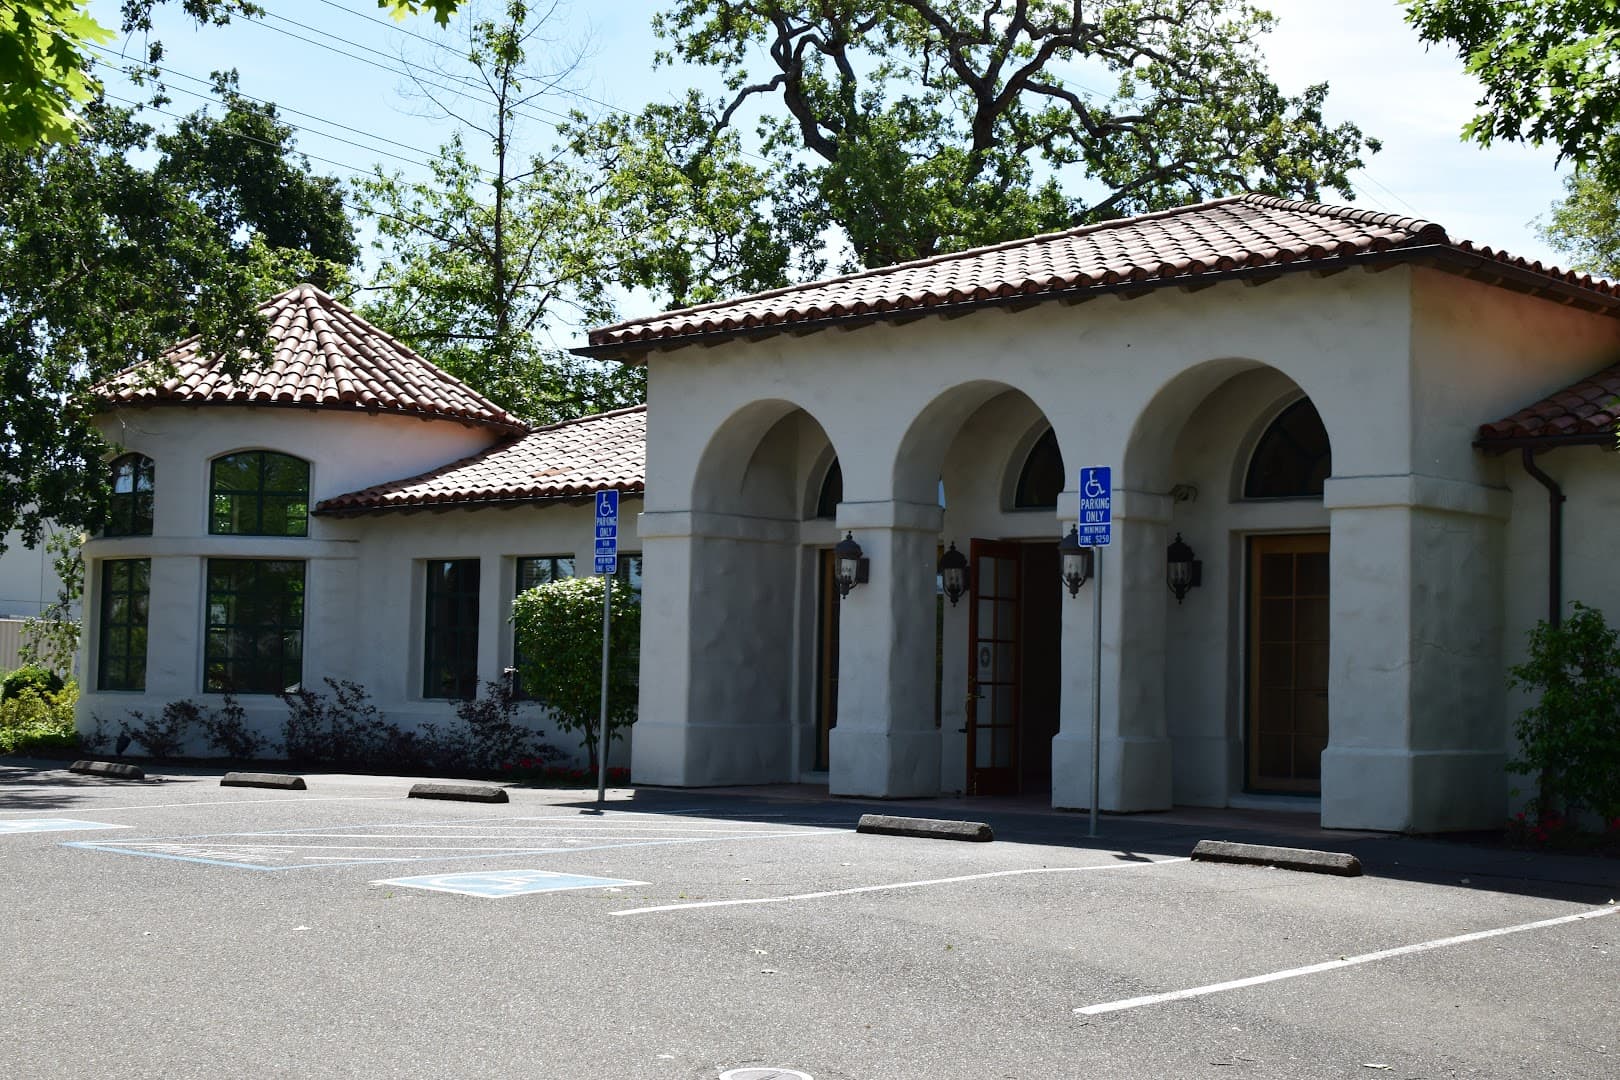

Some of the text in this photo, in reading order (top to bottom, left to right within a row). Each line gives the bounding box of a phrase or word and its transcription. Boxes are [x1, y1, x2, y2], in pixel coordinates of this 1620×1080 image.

[1081, 498, 1110, 510] PARKING
[1086, 511, 1104, 522] ONLY
[600, 528, 612, 536] ONLY
